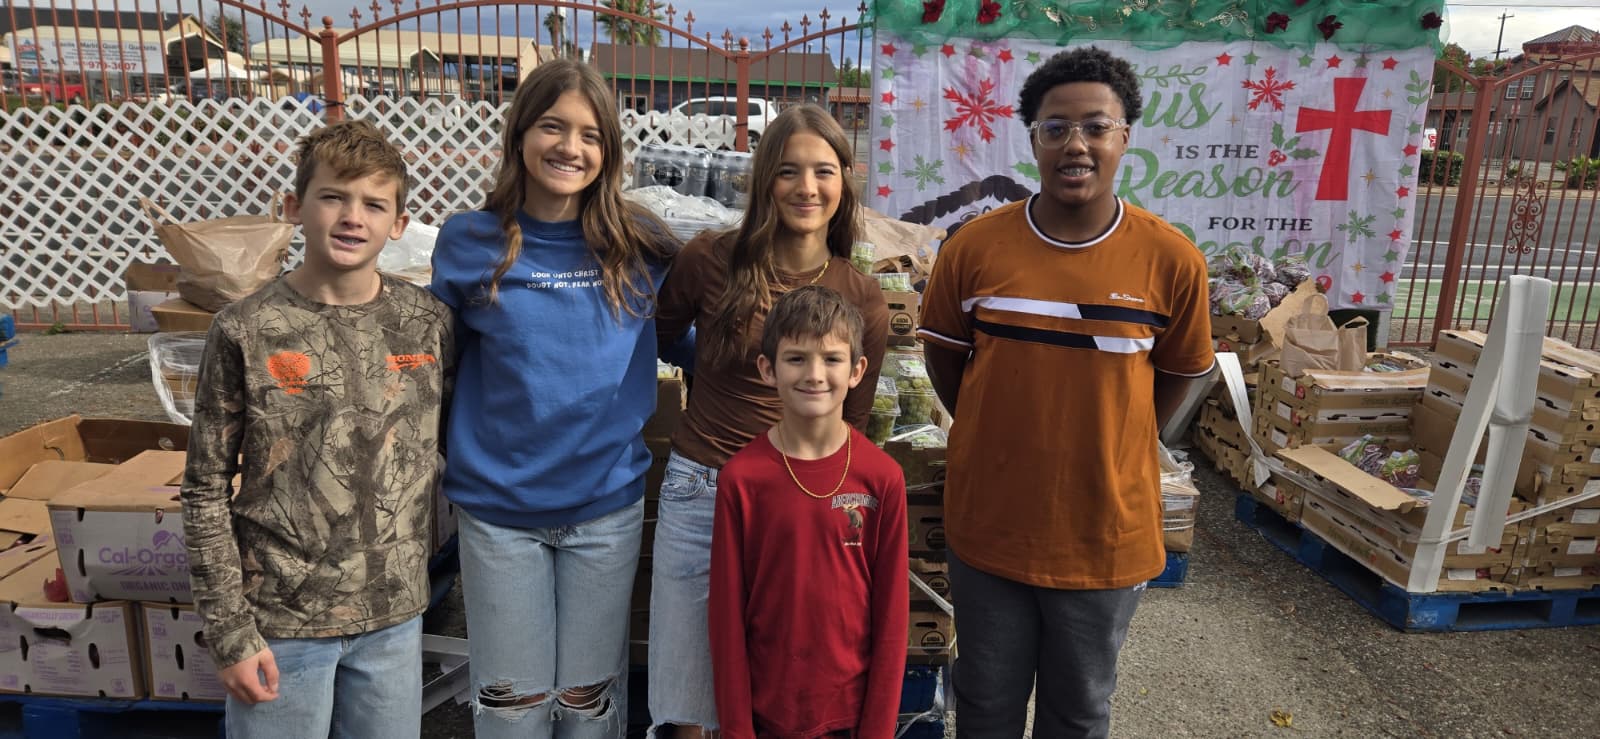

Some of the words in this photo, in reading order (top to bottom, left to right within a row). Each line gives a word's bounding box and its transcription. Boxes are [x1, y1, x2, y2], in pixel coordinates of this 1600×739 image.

[1132, 82, 1224, 130] us
[1175, 144, 1200, 160] IS
[1206, 143, 1260, 159] THE
[1115, 147, 1302, 212] Reason
[1207, 216, 1257, 231] FOR
[1264, 217, 1314, 232] THE
[552, 271, 573, 279] UNTO
[574, 269, 599, 278] CHRIST
[592, 279, 606, 288] NO
[98, 546, 188, 569] Cal-Orga
